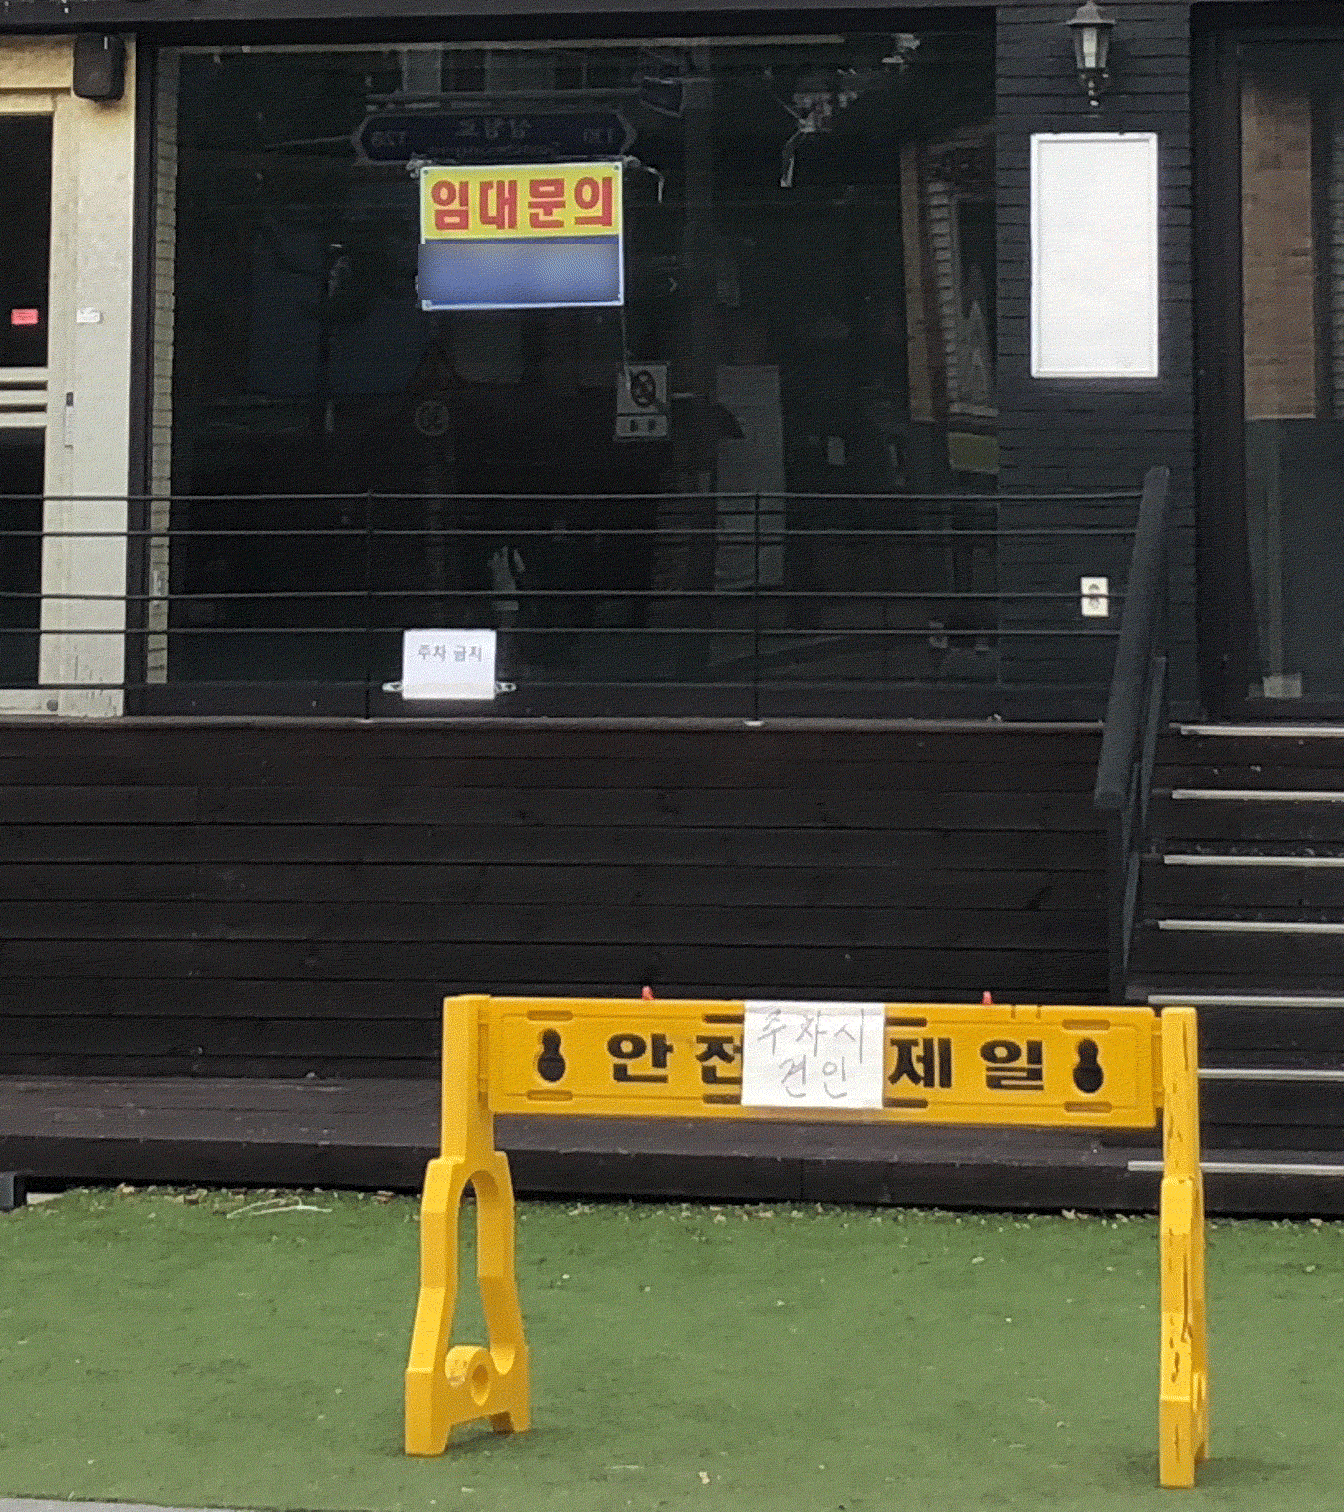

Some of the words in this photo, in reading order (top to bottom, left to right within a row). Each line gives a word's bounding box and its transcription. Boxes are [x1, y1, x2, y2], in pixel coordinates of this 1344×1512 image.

[430, 176, 614, 231] 임대문의
[418, 644, 446, 661] 주차
[454, 644, 483, 662] 금지
[887, 1035, 1045, 1091] 제일
